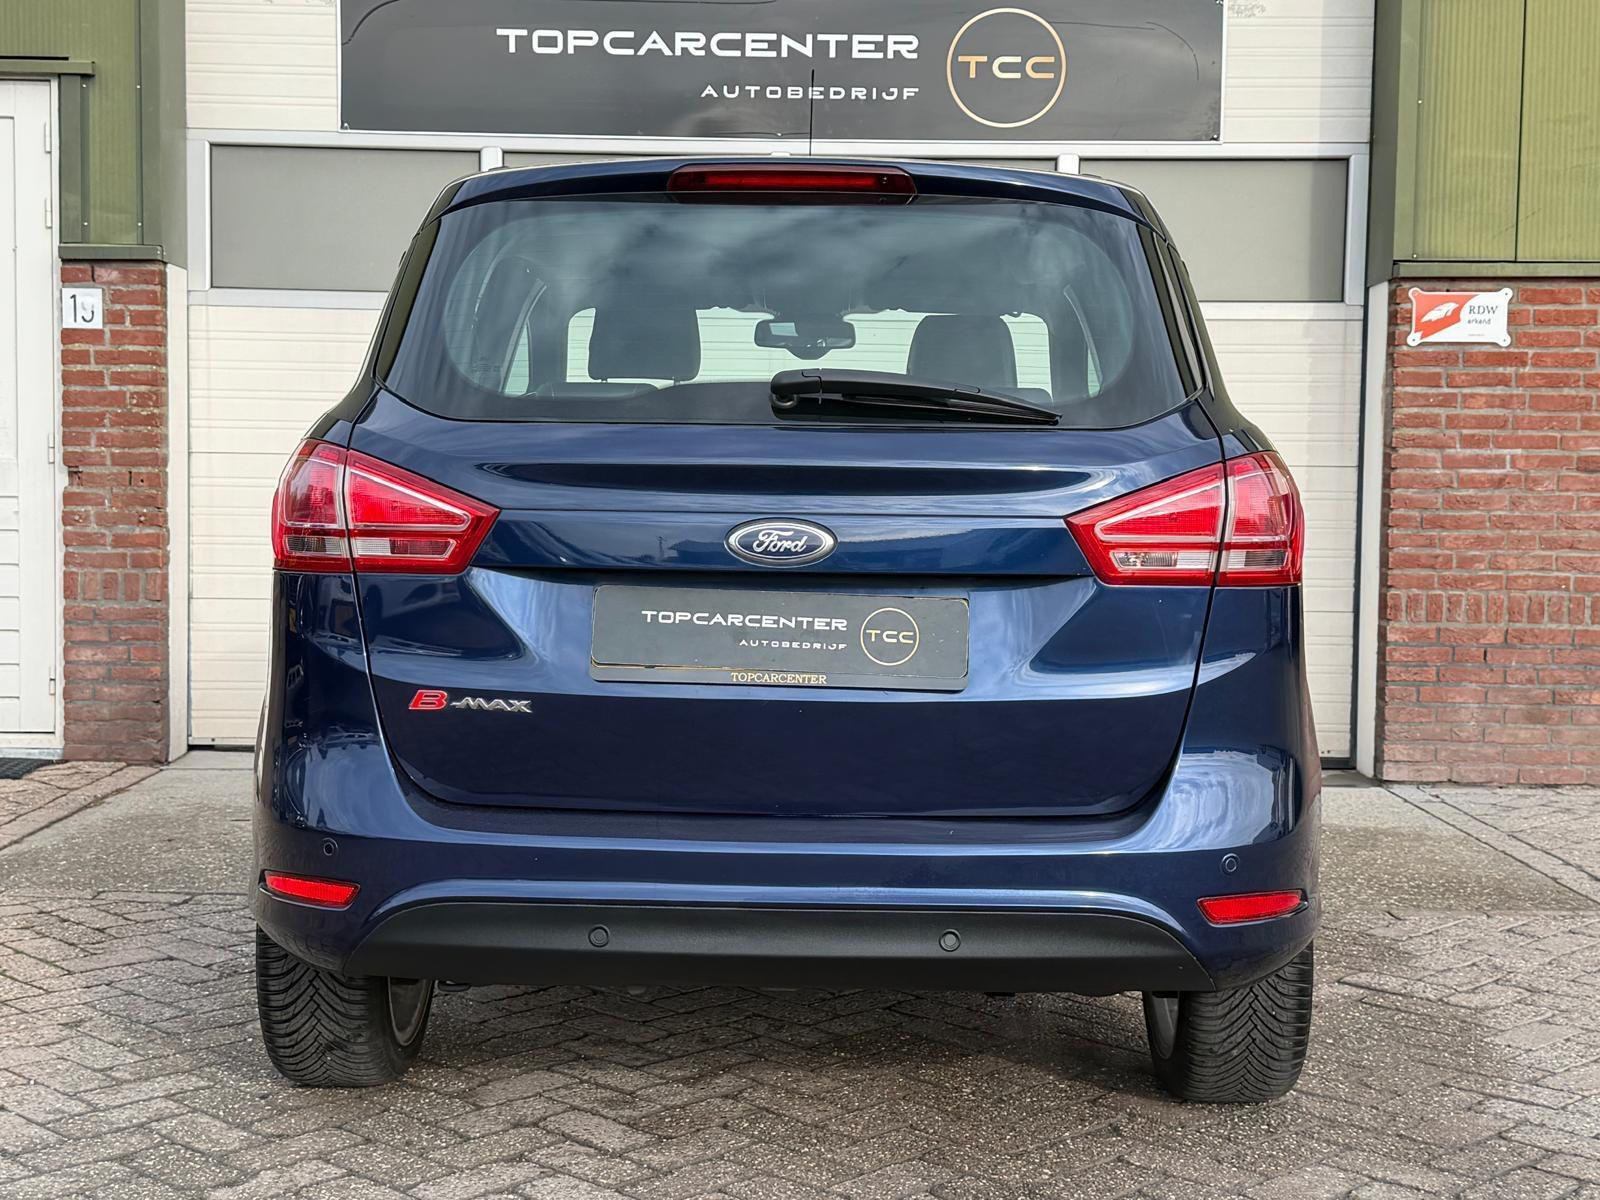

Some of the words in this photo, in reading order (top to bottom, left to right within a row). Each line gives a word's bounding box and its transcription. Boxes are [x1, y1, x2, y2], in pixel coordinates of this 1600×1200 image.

[496, 28, 919, 60] TOPCARCENTER
[958, 55, 1056, 79] TCC
[700, 84, 920, 101] AUTOBEDRIJF
[1468, 305, 1498, 315] RDW
[752, 529, 808, 552] Ford
[641, 610, 848, 631] TOPCARCENTER
[739, 639, 847, 650] AUTOBEDRIJF
[866, 629, 914, 644] TCC
[731, 672, 828, 685] TOPCARCENTER
[408, 689, 533, 713] B-MAX
